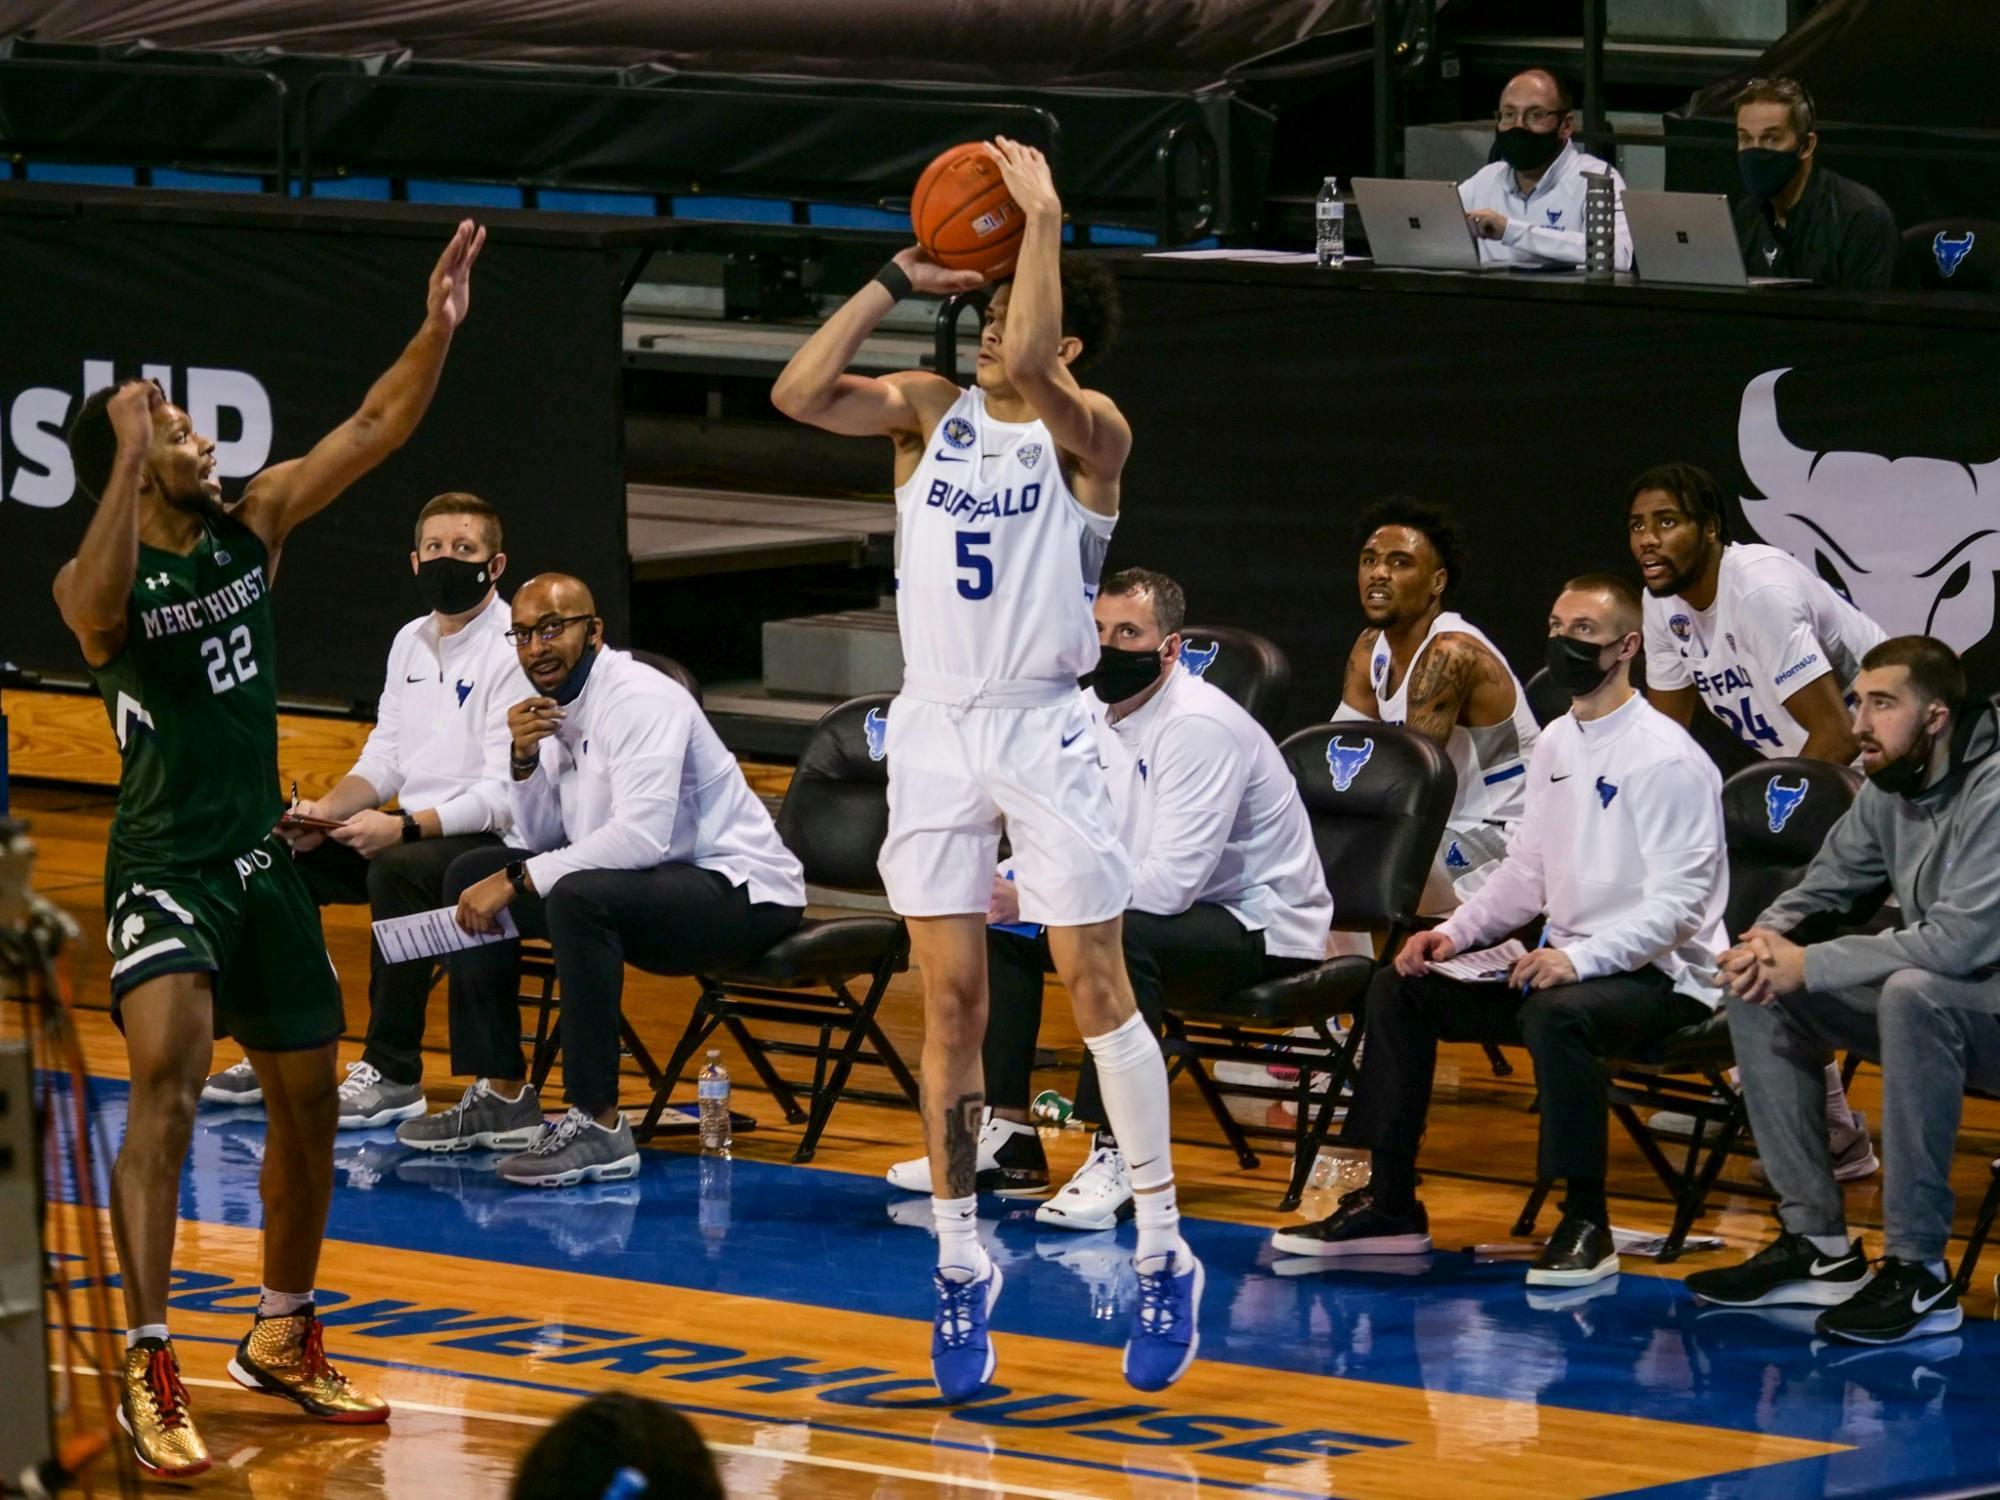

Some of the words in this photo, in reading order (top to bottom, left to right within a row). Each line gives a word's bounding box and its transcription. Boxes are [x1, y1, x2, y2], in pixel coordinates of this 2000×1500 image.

[955, 530, 993, 601] 5
[201, 623, 258, 694] 22
[1713, 696, 1784, 748] 24
